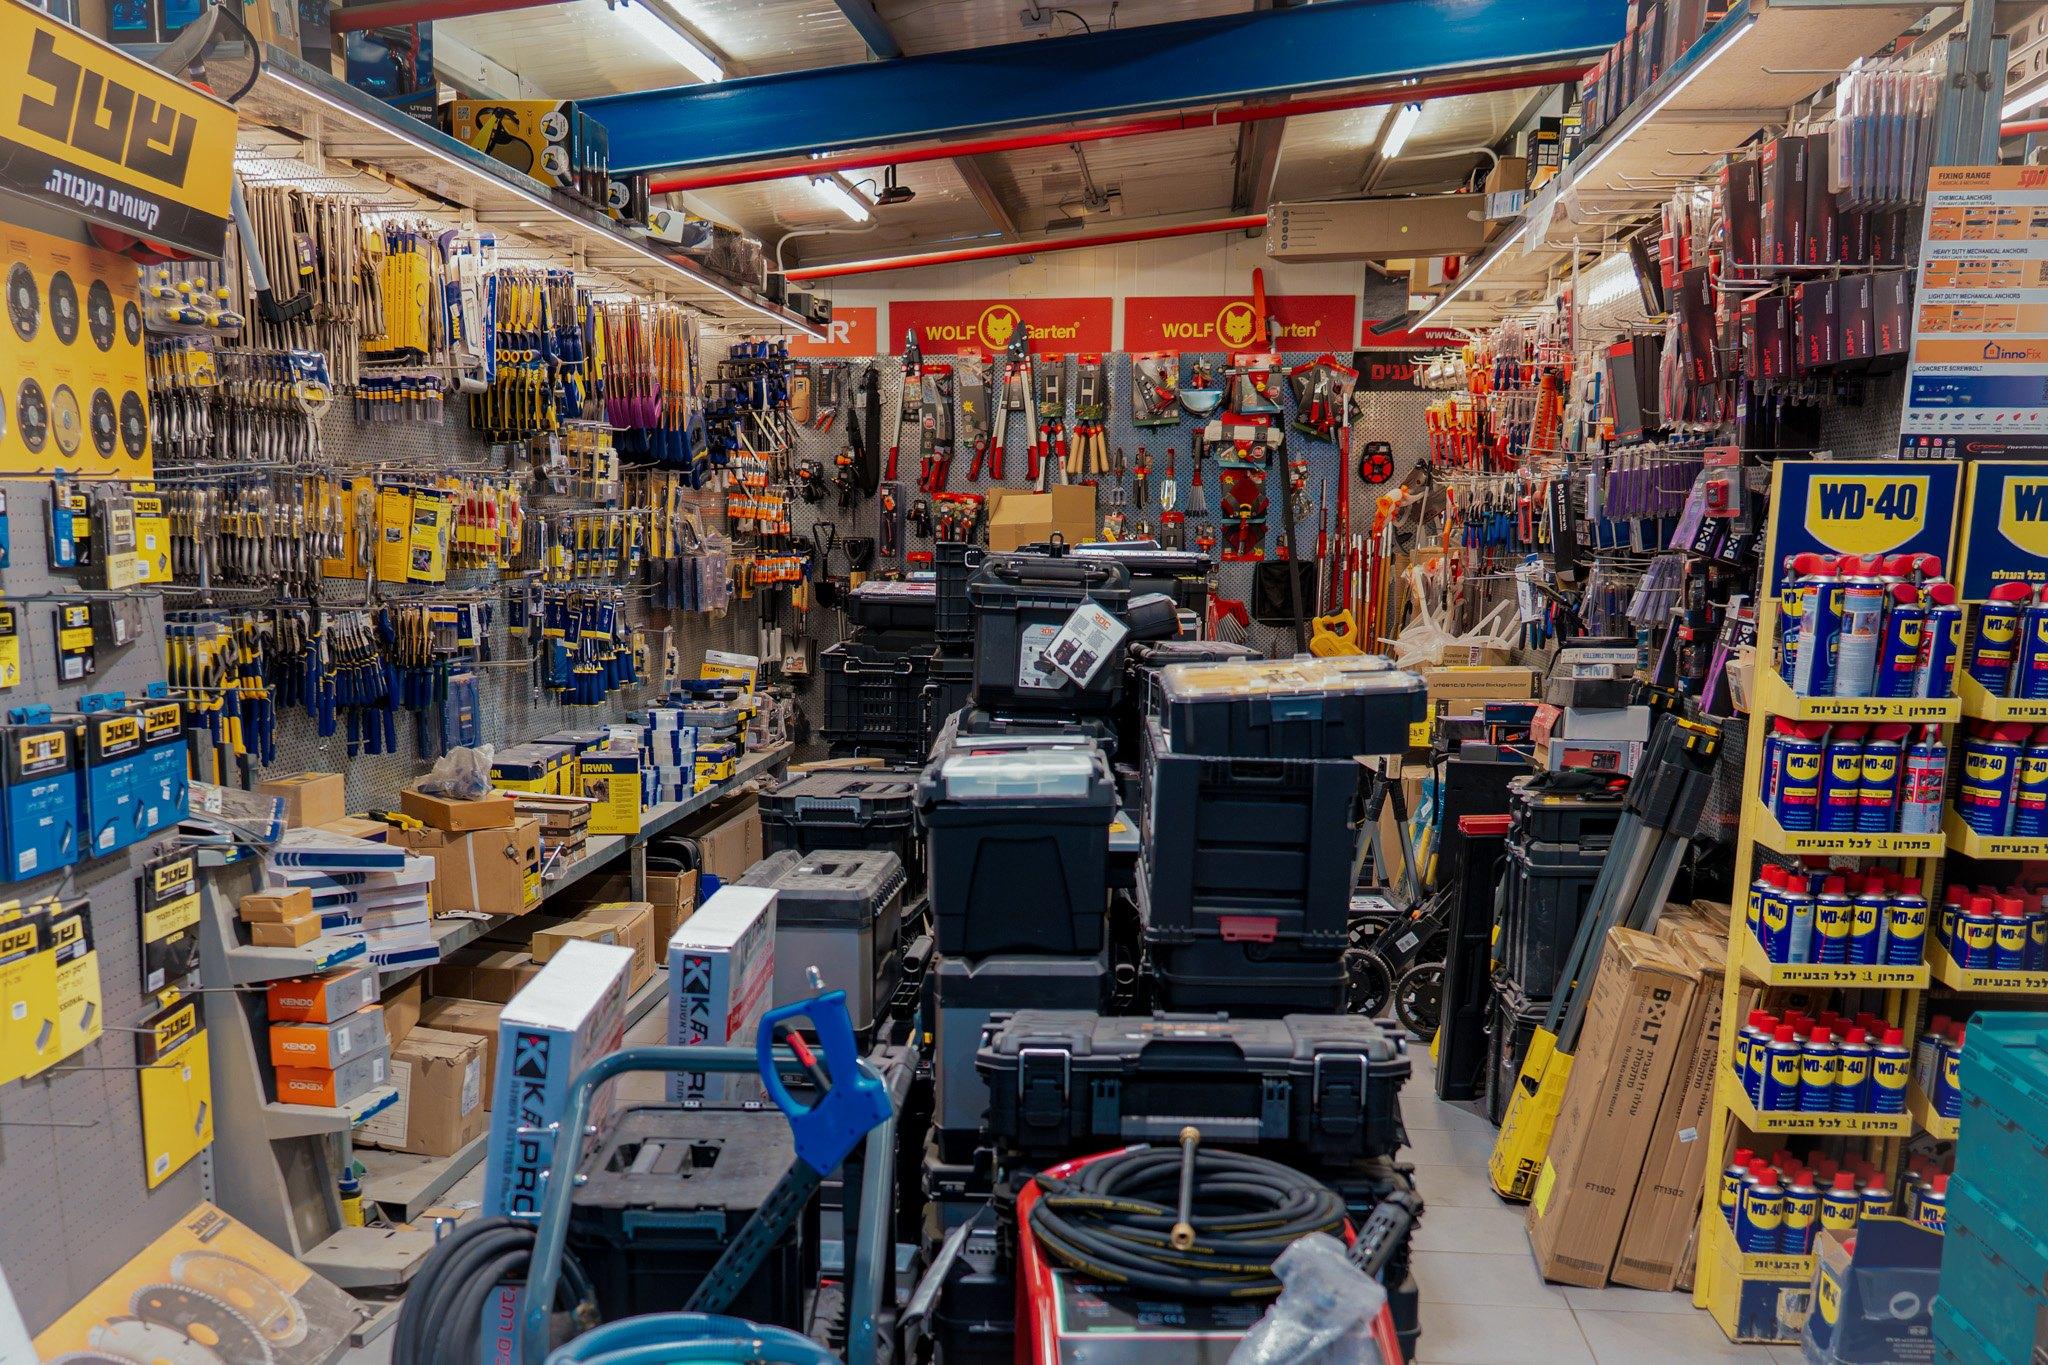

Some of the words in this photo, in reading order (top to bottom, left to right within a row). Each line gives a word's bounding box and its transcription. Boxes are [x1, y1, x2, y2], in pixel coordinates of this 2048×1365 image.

[1938, 172, 1963, 180] FIXING
[45, 167, 106, 210] בעבודה.
[107, 187, 160, 230] קשוחים
[926, 325, 976, 341] WOLF
[1162, 322, 1214, 338] WOLF
[1819, 483, 1918, 521] WD-40
[1810, 705, 1859, 716] הבעיות
[1863, 704, 1887, 715] לכל
[1908, 705, 1947, 717] פתרון
[2007, 706, 2047, 716] בעיות
[582, 763, 614, 773] IRWIN
[1796, 839, 1844, 849] הבעיות
[1848, 838, 1872, 849] לכל
[1893, 840, 1931, 850] פתרון
[1990, 843, 2039, 854] הבעיות
[1891, 911, 1924, 925] WD-40
[1782, 971, 1829, 982] הבעיות
[1833, 970, 1857, 980] לכל
[1877, 973, 1915, 982] פתרון
[1973, 977, 2020, 987] הבעיות
[282, 1042, 316, 1052] KENDO
[1627, 1048, 1644, 1089] מתקפלת
[1803, 1058, 1835, 1073] WD-40
[1767, 1118, 1814, 1129] הבעיות
[1818, 1118, 1841, 1128] לכל
[1862, 1120, 1898, 1130] פתרון
[1585, 1182, 1616, 1196] FT1302
[1751, 1200, 1783, 1216] WD-40
[1823, 1204, 1854, 1220] WD-40
